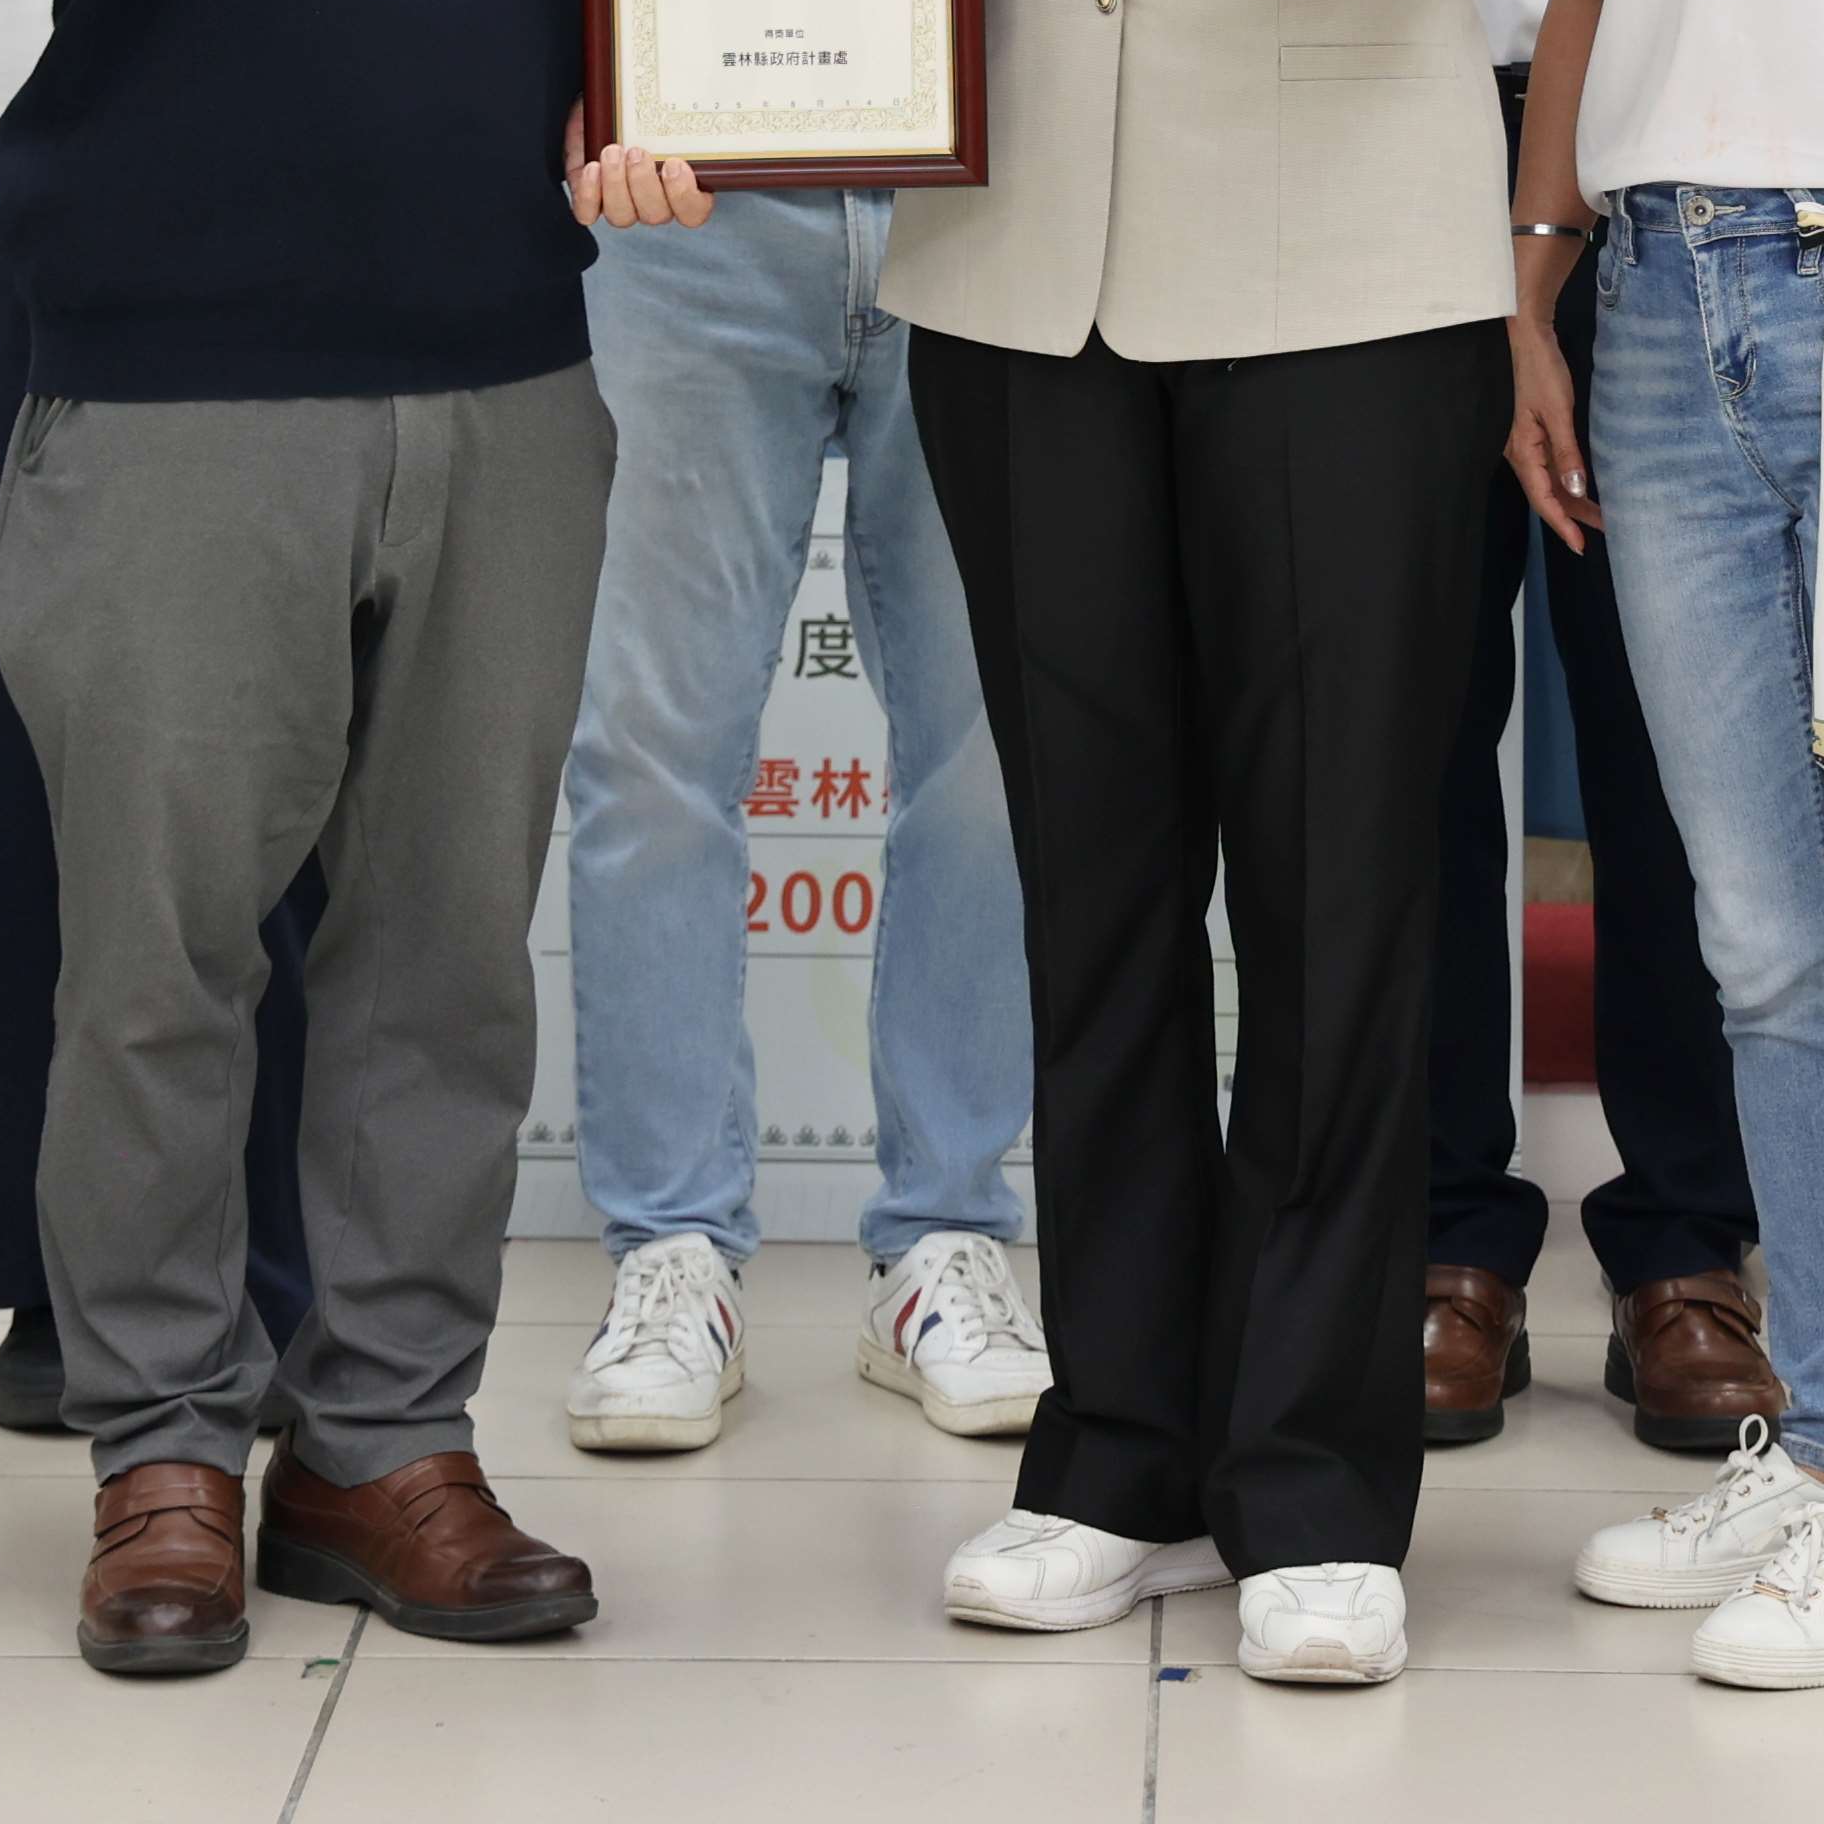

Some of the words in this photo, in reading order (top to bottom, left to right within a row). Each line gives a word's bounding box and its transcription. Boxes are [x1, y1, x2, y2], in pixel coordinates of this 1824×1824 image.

[722, 50, 849, 67] 雲林縣政府計畫處
[778, 611, 860, 681] 度
[743, 755, 892, 822] 雲林
